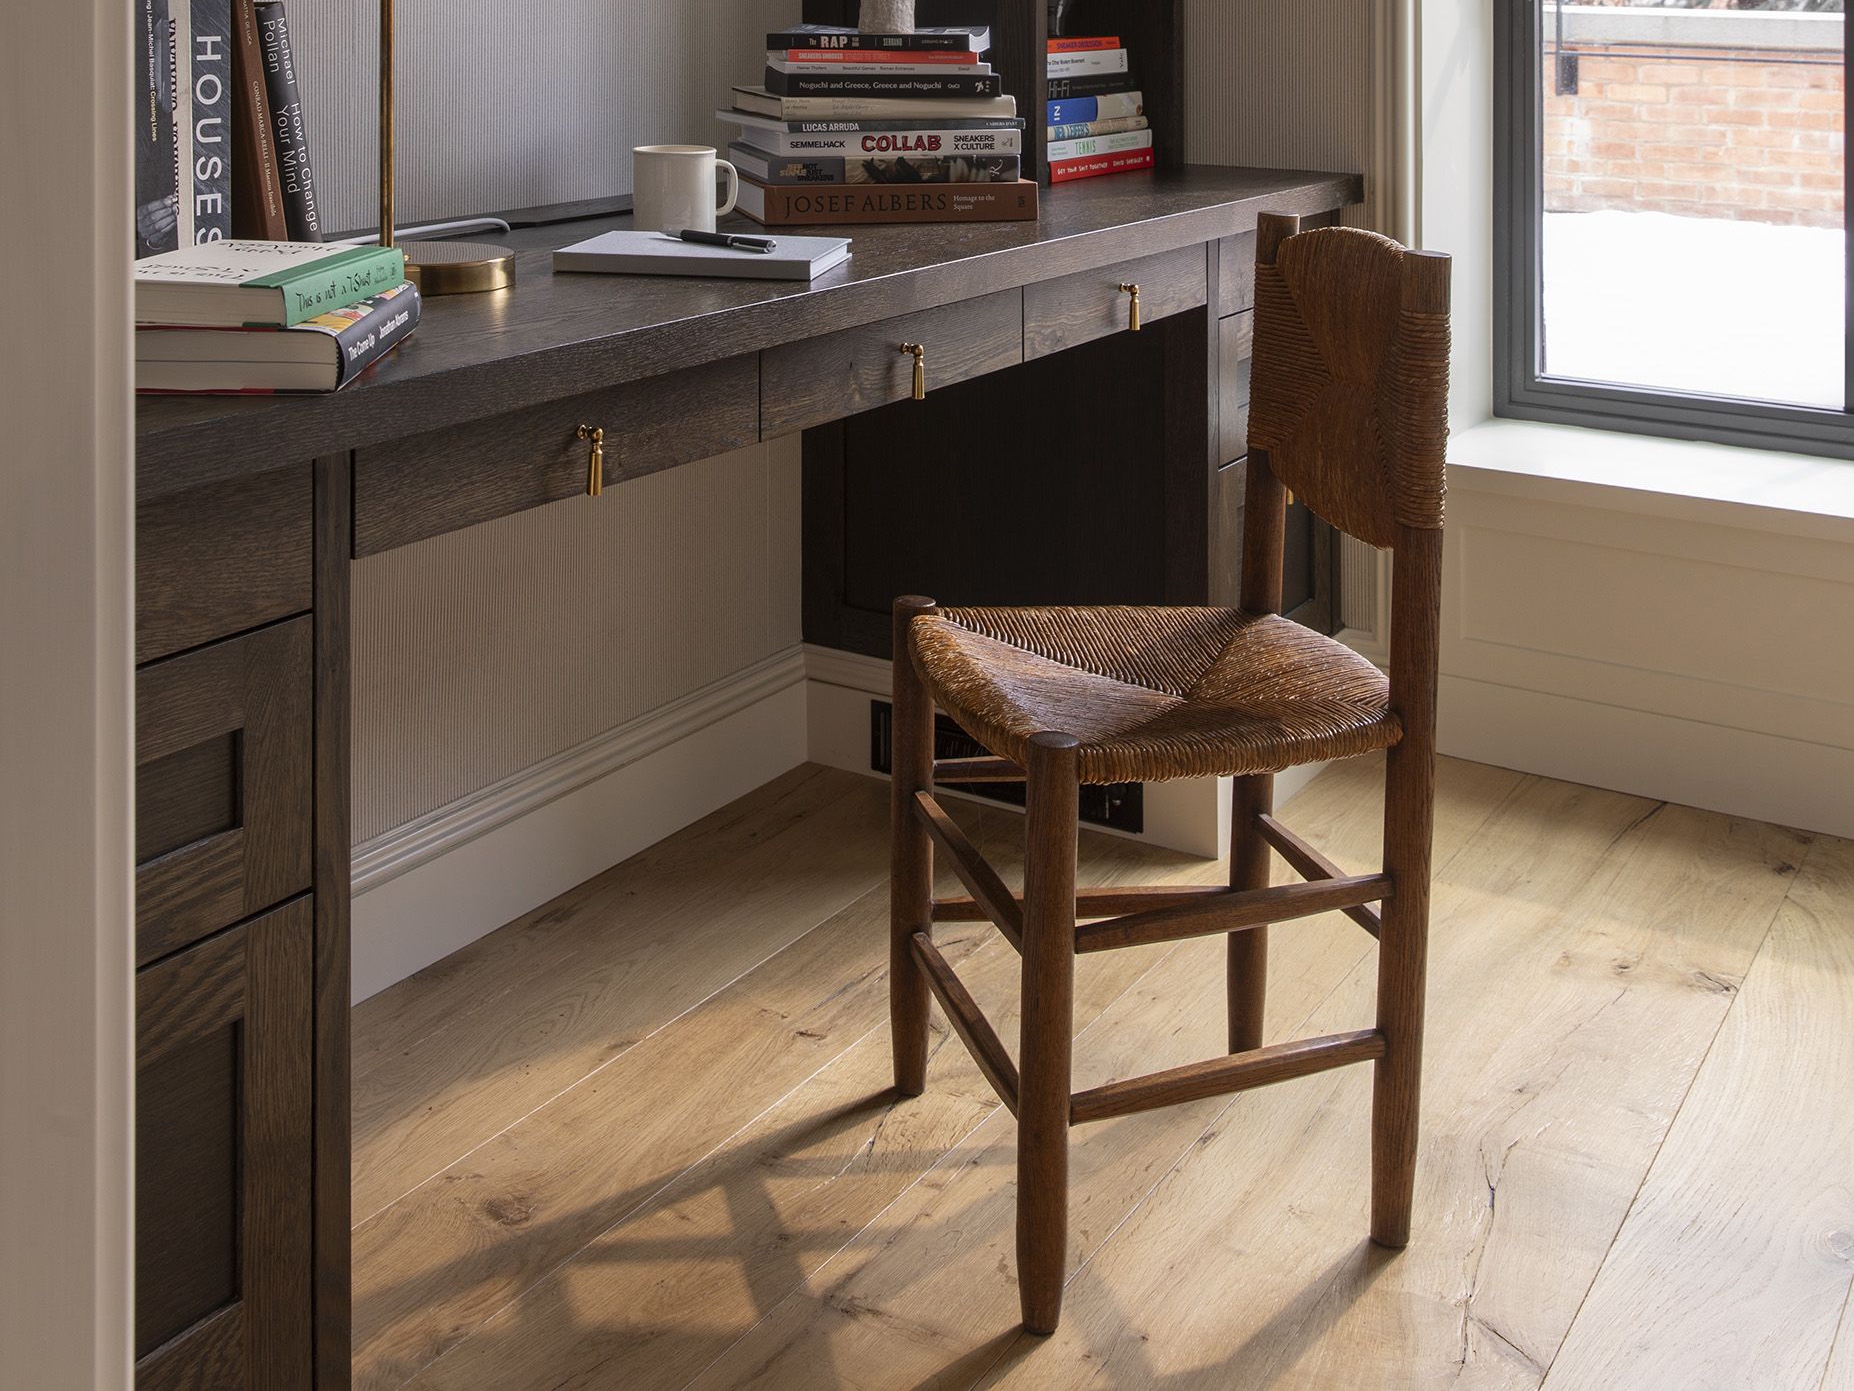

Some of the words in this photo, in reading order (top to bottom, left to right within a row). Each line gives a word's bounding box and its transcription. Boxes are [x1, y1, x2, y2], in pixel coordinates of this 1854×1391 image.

[242, 0, 250, 19] MATTIA
[264, 20, 280, 73] Pollan
[278, 17, 296, 85] Michael
[820, 36, 847, 48] RAP
[148, 57, 156, 91] Basquiat:
[799, 81, 829, 90] Noguchi
[830, 81, 843, 89] and
[844, 81, 871, 90] Greece,
[873, 81, 898, 89] Greece
[899, 81, 912, 89] and
[913, 81, 942, 90] Noguchi
[253, 81, 263, 112] CONRAD
[1048, 80, 1070, 99] Hi-Fi
[149, 91, 157, 121] Crossing
[277, 105, 291, 144] Your
[291, 102, 303, 141] How
[802, 123, 828, 131] LUCAS
[828, 123, 860, 131] ARRUDA
[195, 35, 223, 246] HOUSES
[790, 140, 845, 148] SEMMELHACK
[861, 134, 942, 151] COLLAB
[953, 135, 995, 143] SNEAKERS
[1075, 139, 1096, 155] TENNIS
[298, 146, 307, 162] to
[1057, 167, 1066, 175] GET
[1089, 162, 1108, 170] TOGETHER
[1113, 159, 1124, 167] DAVID
[282, 150, 300, 193] Mind
[301, 167, 318, 232] Change
[785, 195, 855, 219] JOSEF
[862, 193, 946, 212] ALBERS
[953, 195, 977, 203] Homage
[296, 292, 313, 311] This
[315, 293, 322, 303] is
[325, 280, 337, 300] not
[341, 285, 347, 295] a
[348, 346, 357, 361] The
[356, 338, 369, 356] Come
[368, 332, 376, 349] Up
[379, 317, 395, 339] Jonathan
[394, 310, 409, 328] Abrams
